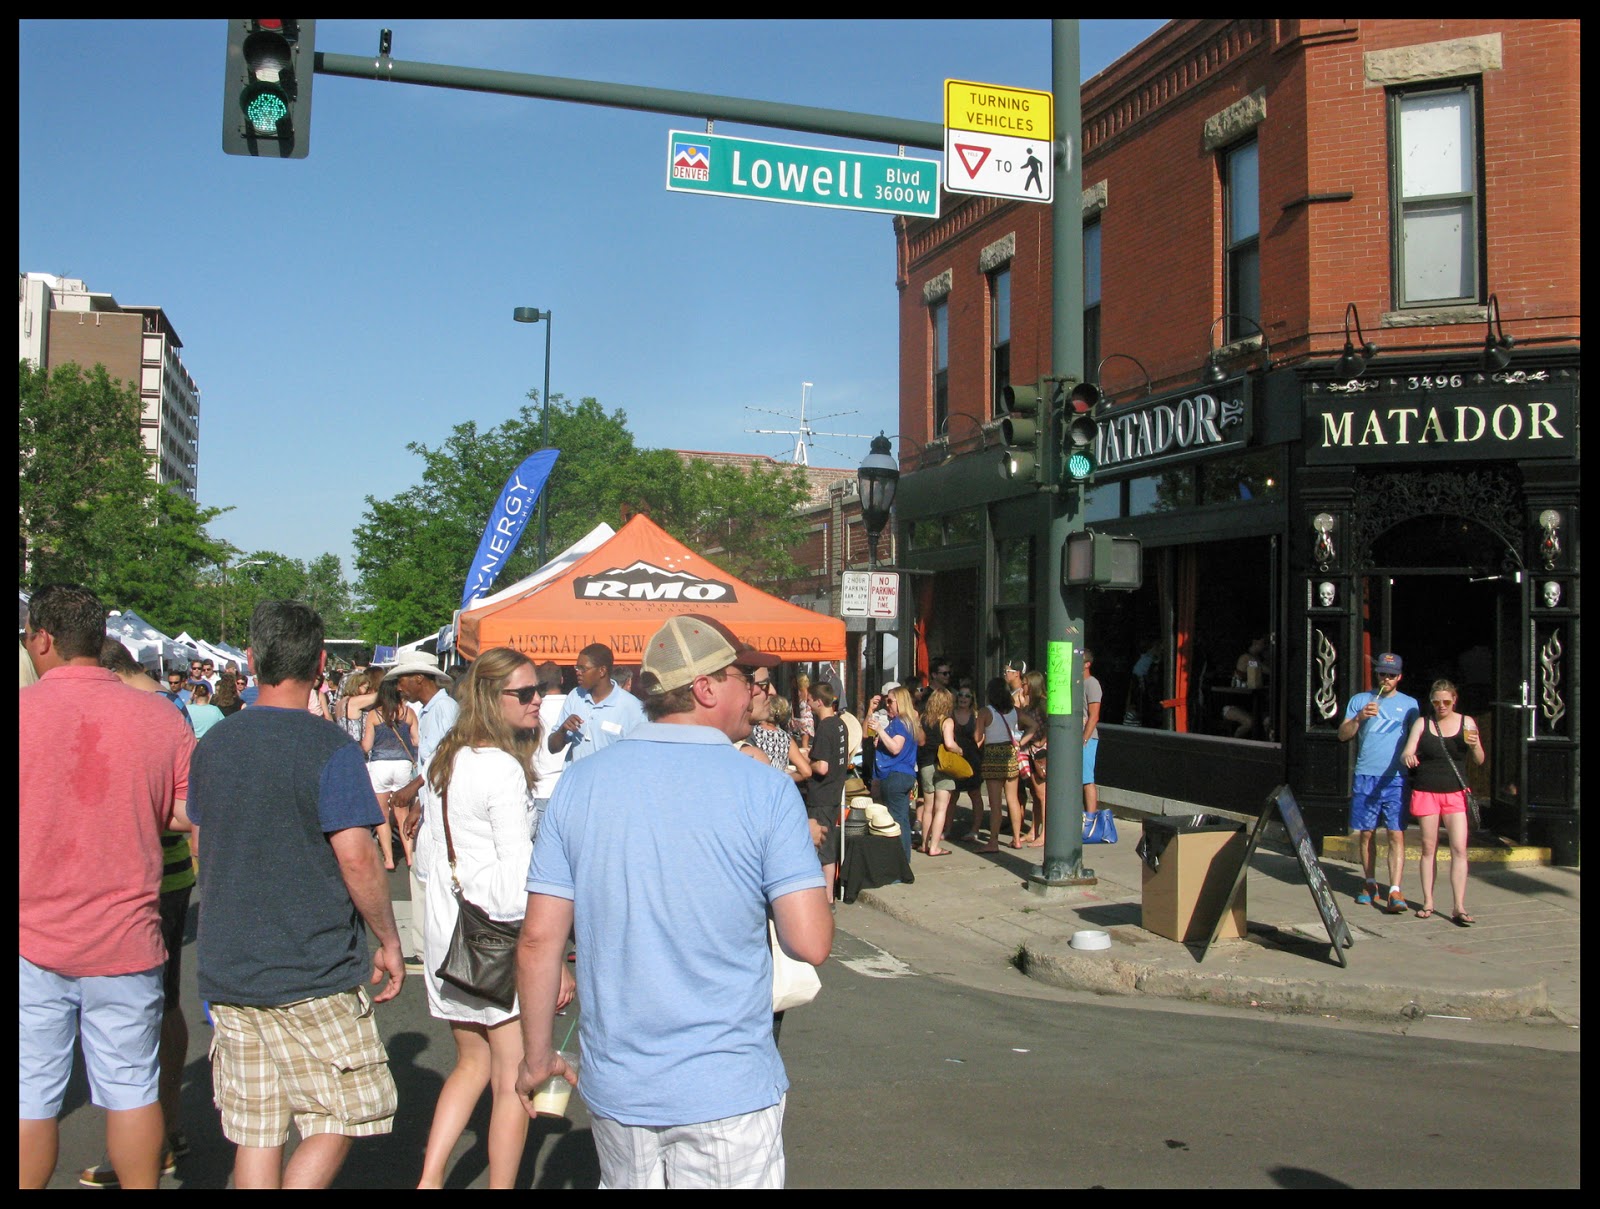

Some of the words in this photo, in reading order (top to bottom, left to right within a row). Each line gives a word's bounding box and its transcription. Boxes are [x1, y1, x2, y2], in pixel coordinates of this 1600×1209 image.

[970, 92, 1030, 112] TURNING
[966, 111, 1034, 132] VEHICLES
[673, 166, 708, 181] DENVER
[732, 150, 863, 199] Lowell
[995, 159, 1012, 173] TO
[886, 168, 920, 186] Blvd
[1407, 374, 1463, 390] 3496
[1321, 402, 1564, 447] MATADOR
[583, 580, 727, 600] RMO
[879, 577, 890, 585] NO
[871, 586, 896, 596] PARKING
[610, 635, 645, 654] NEW
